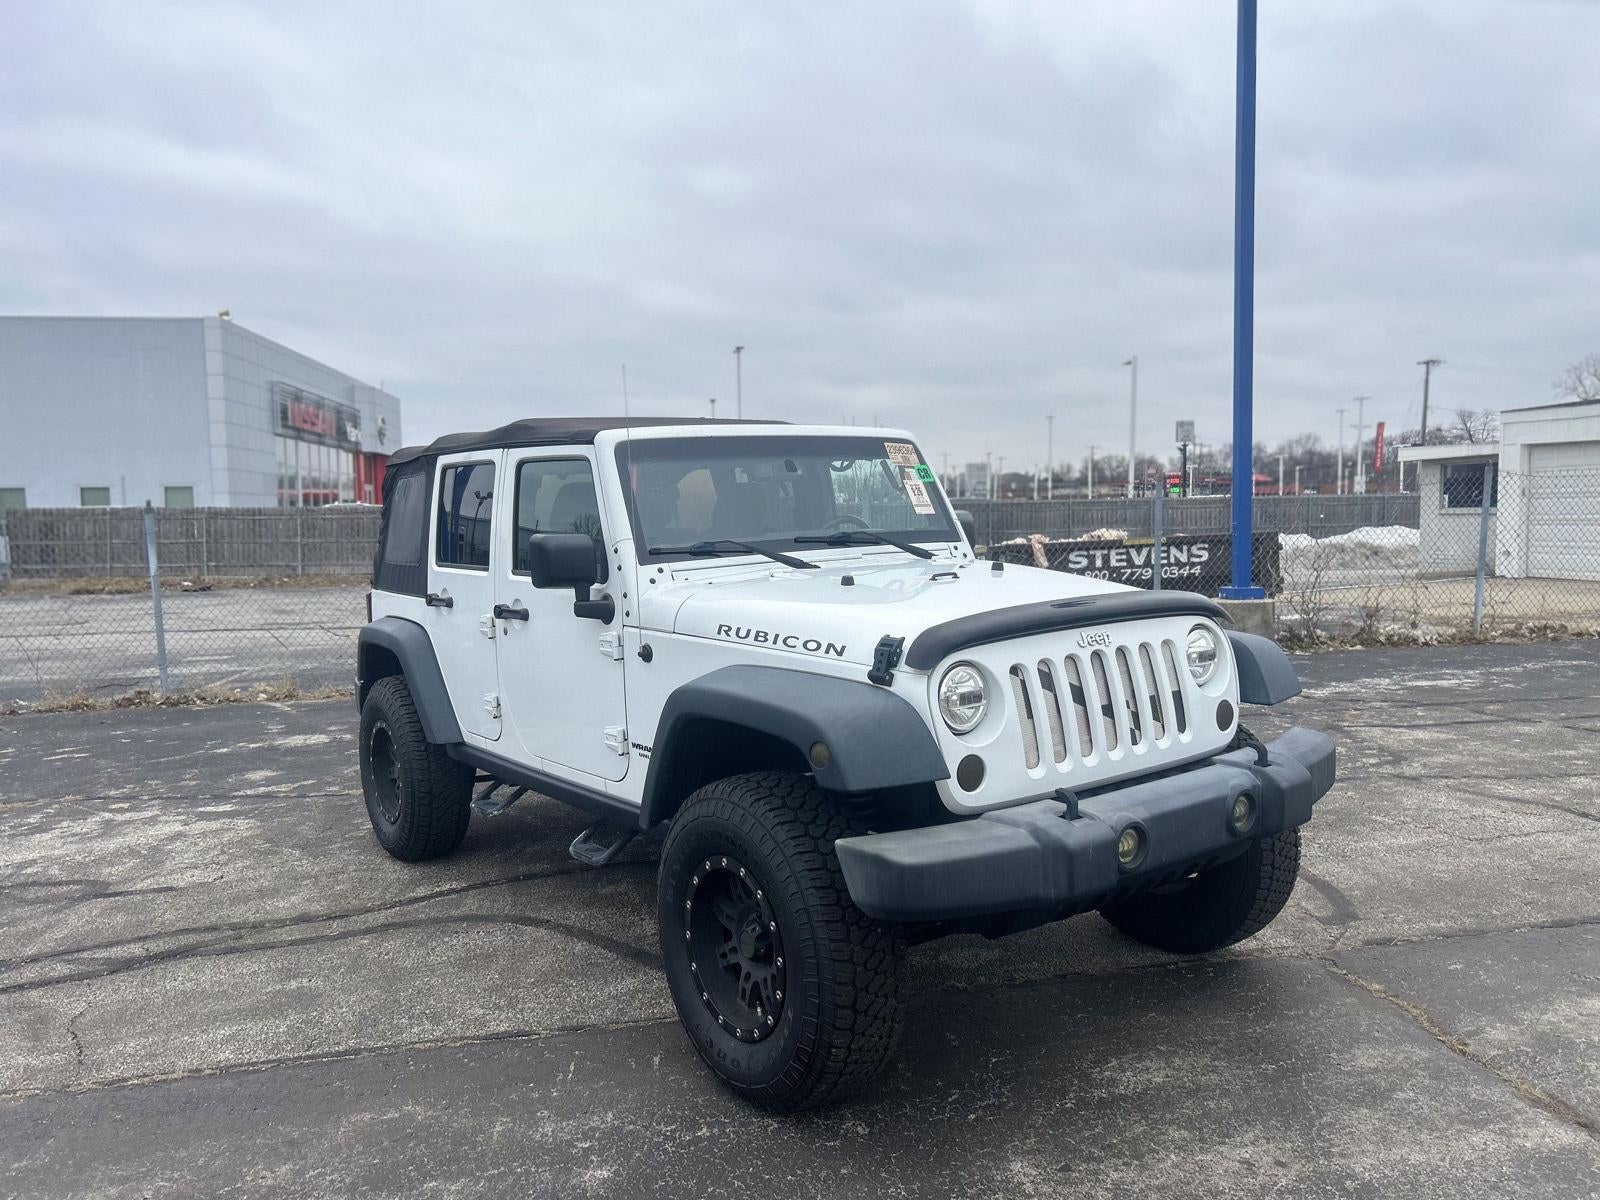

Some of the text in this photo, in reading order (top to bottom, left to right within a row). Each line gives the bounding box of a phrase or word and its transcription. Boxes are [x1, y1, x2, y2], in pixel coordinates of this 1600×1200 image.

[1068, 543, 1209, 569] STEVENS
[716, 623, 847, 657] RUBICON
[1077, 631, 1111, 648] Jeep
